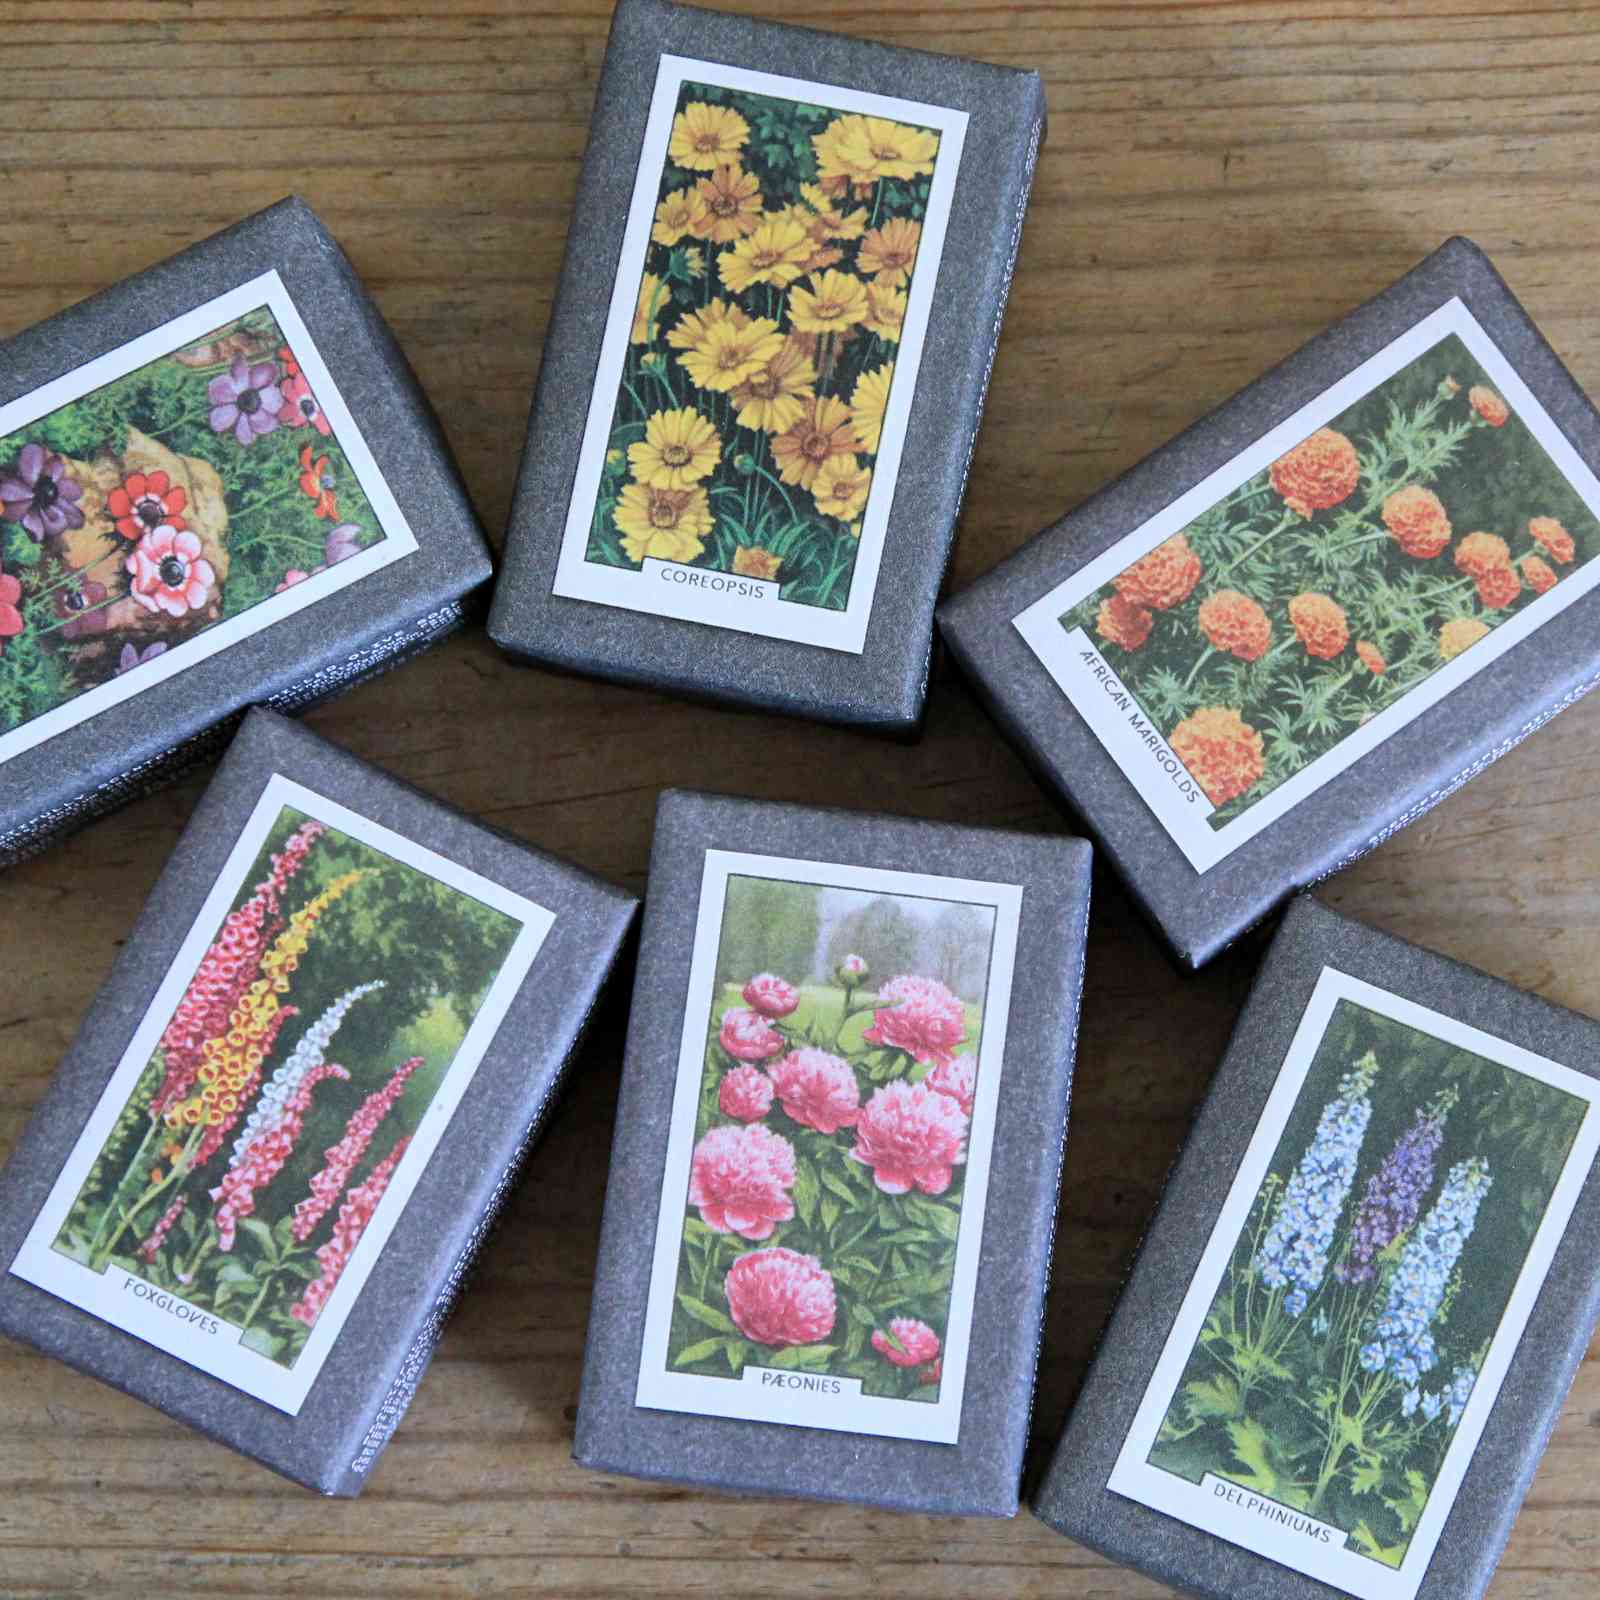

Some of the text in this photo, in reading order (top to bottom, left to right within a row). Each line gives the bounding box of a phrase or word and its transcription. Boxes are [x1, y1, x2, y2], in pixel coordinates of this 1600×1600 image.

[660, 567, 765, 599] COREOPSIS
[1079, 650, 1200, 804] AFRICAN MARIGOLDS
[123, 1277, 220, 1335] FOXGLOVES
[761, 1371, 841, 1394] PÆONIES
[1213, 1482, 1333, 1544] DELPHINIUMS
